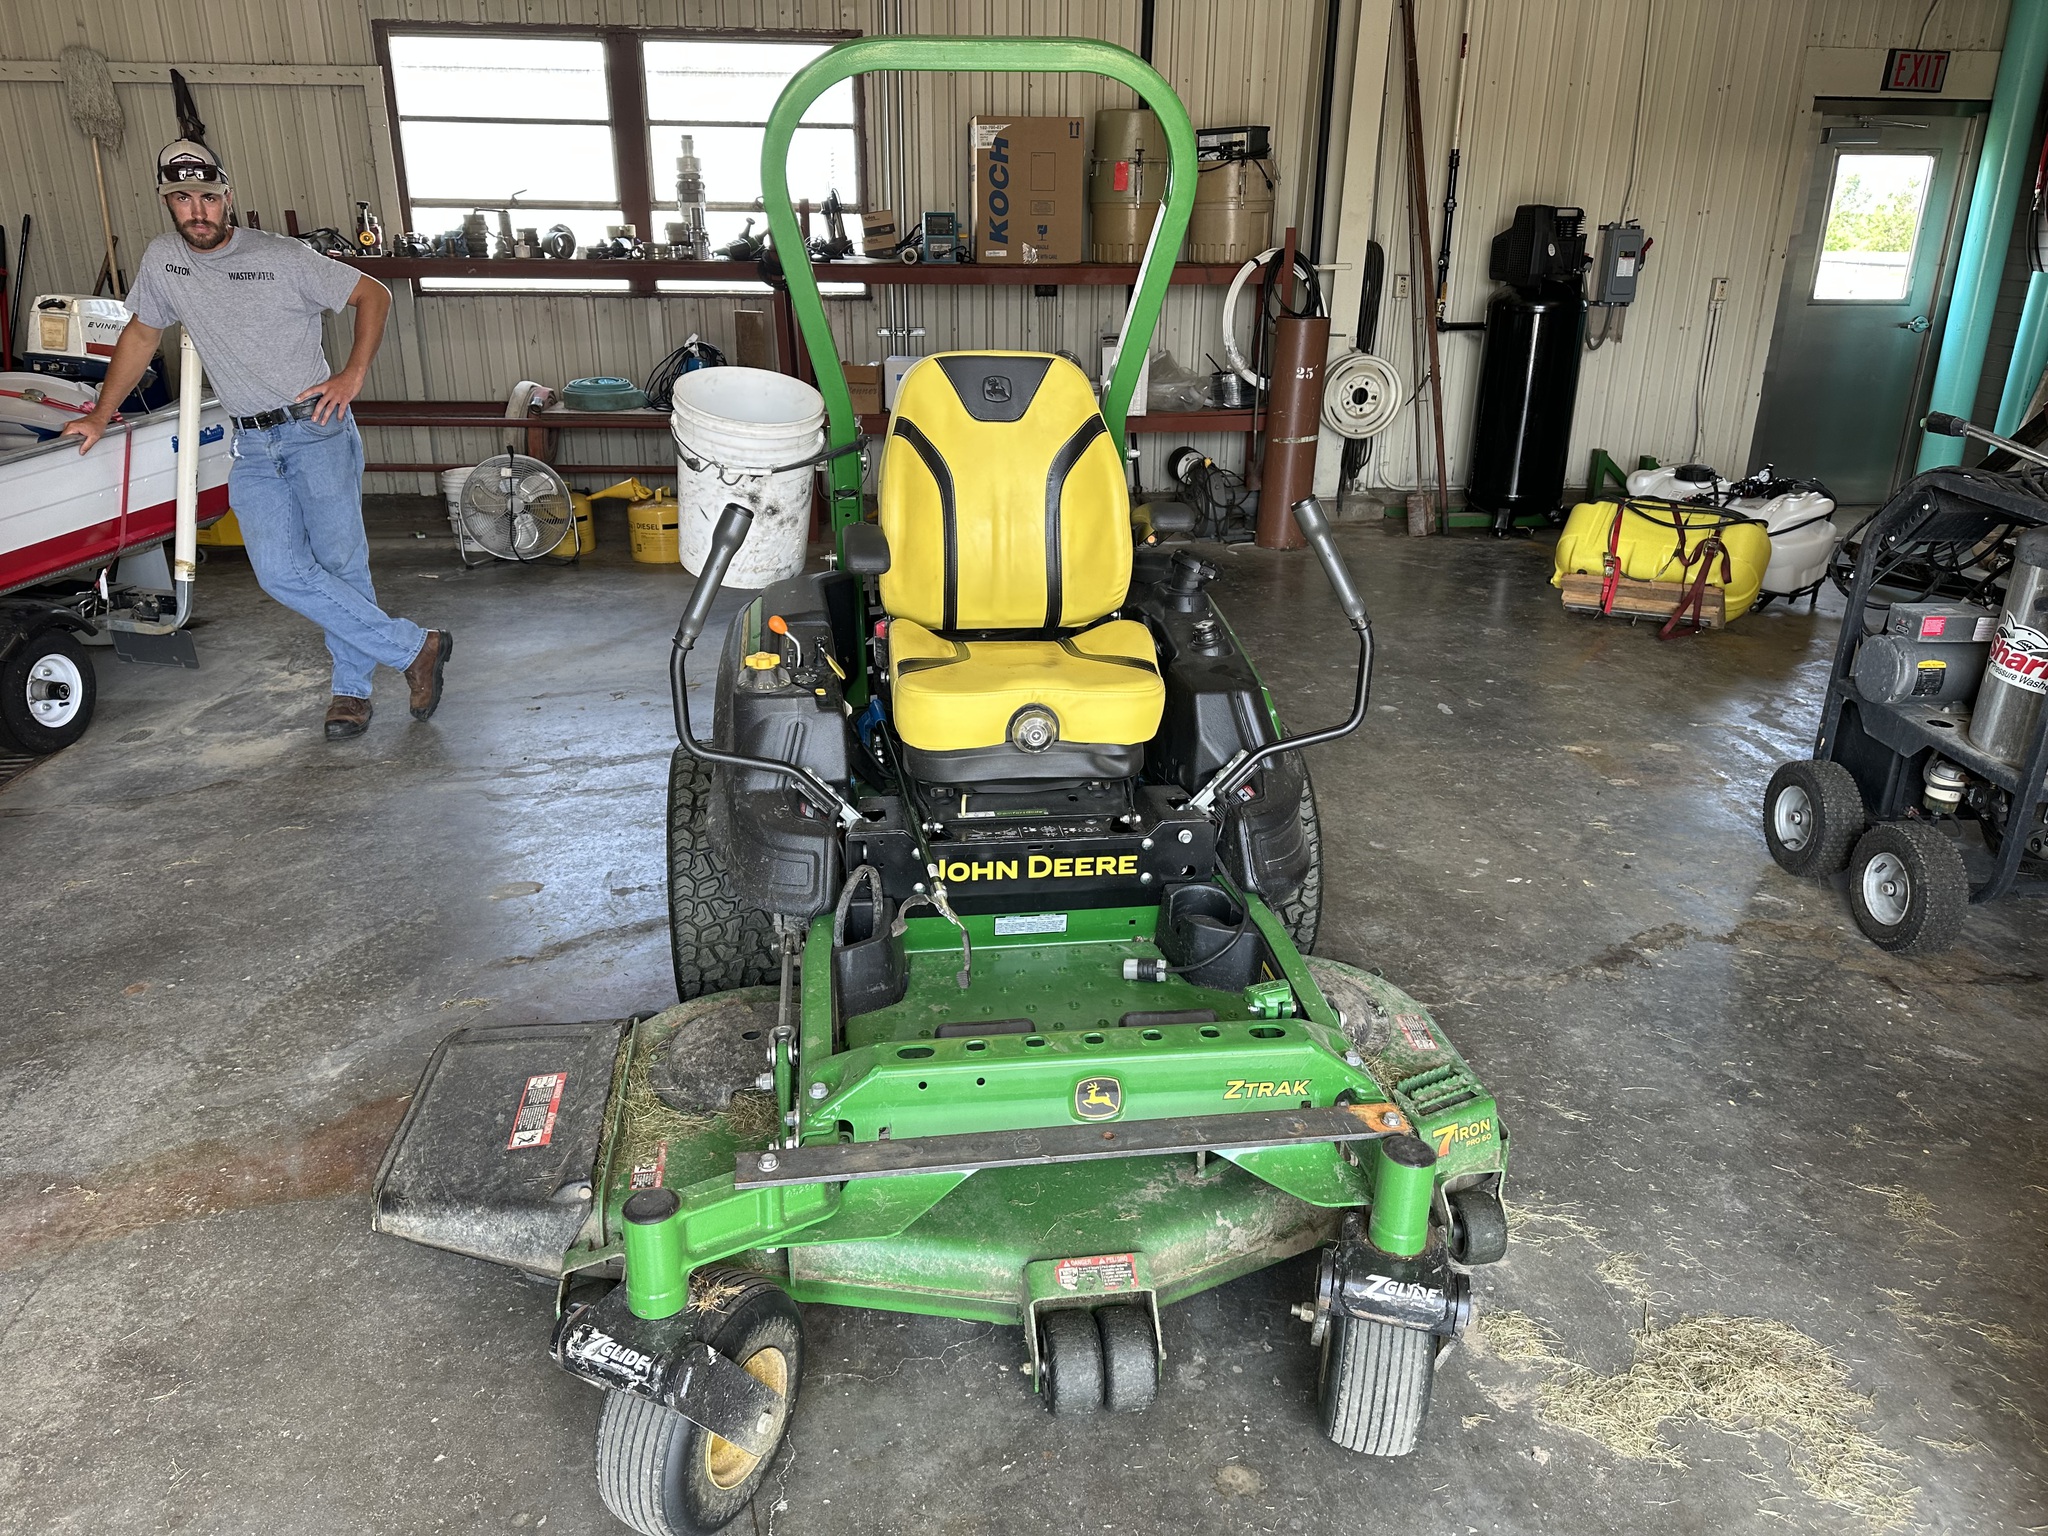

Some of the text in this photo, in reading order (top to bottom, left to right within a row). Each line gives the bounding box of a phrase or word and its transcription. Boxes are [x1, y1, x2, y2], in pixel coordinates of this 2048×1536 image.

[1893, 53, 1946, 88] EXIT
[988, 137, 1009, 245] KOCH
[228, 271, 275, 281] WASTEWATER
[636, 523, 660, 531] DIESEL
[1991, 663, 2018, 681] Pressure
[938, 855, 1138, 882] JOHN DEERE
[1223, 1079, 1313, 1101] ZTRAK
[1465, 1132, 1492, 1148] PRO 60
